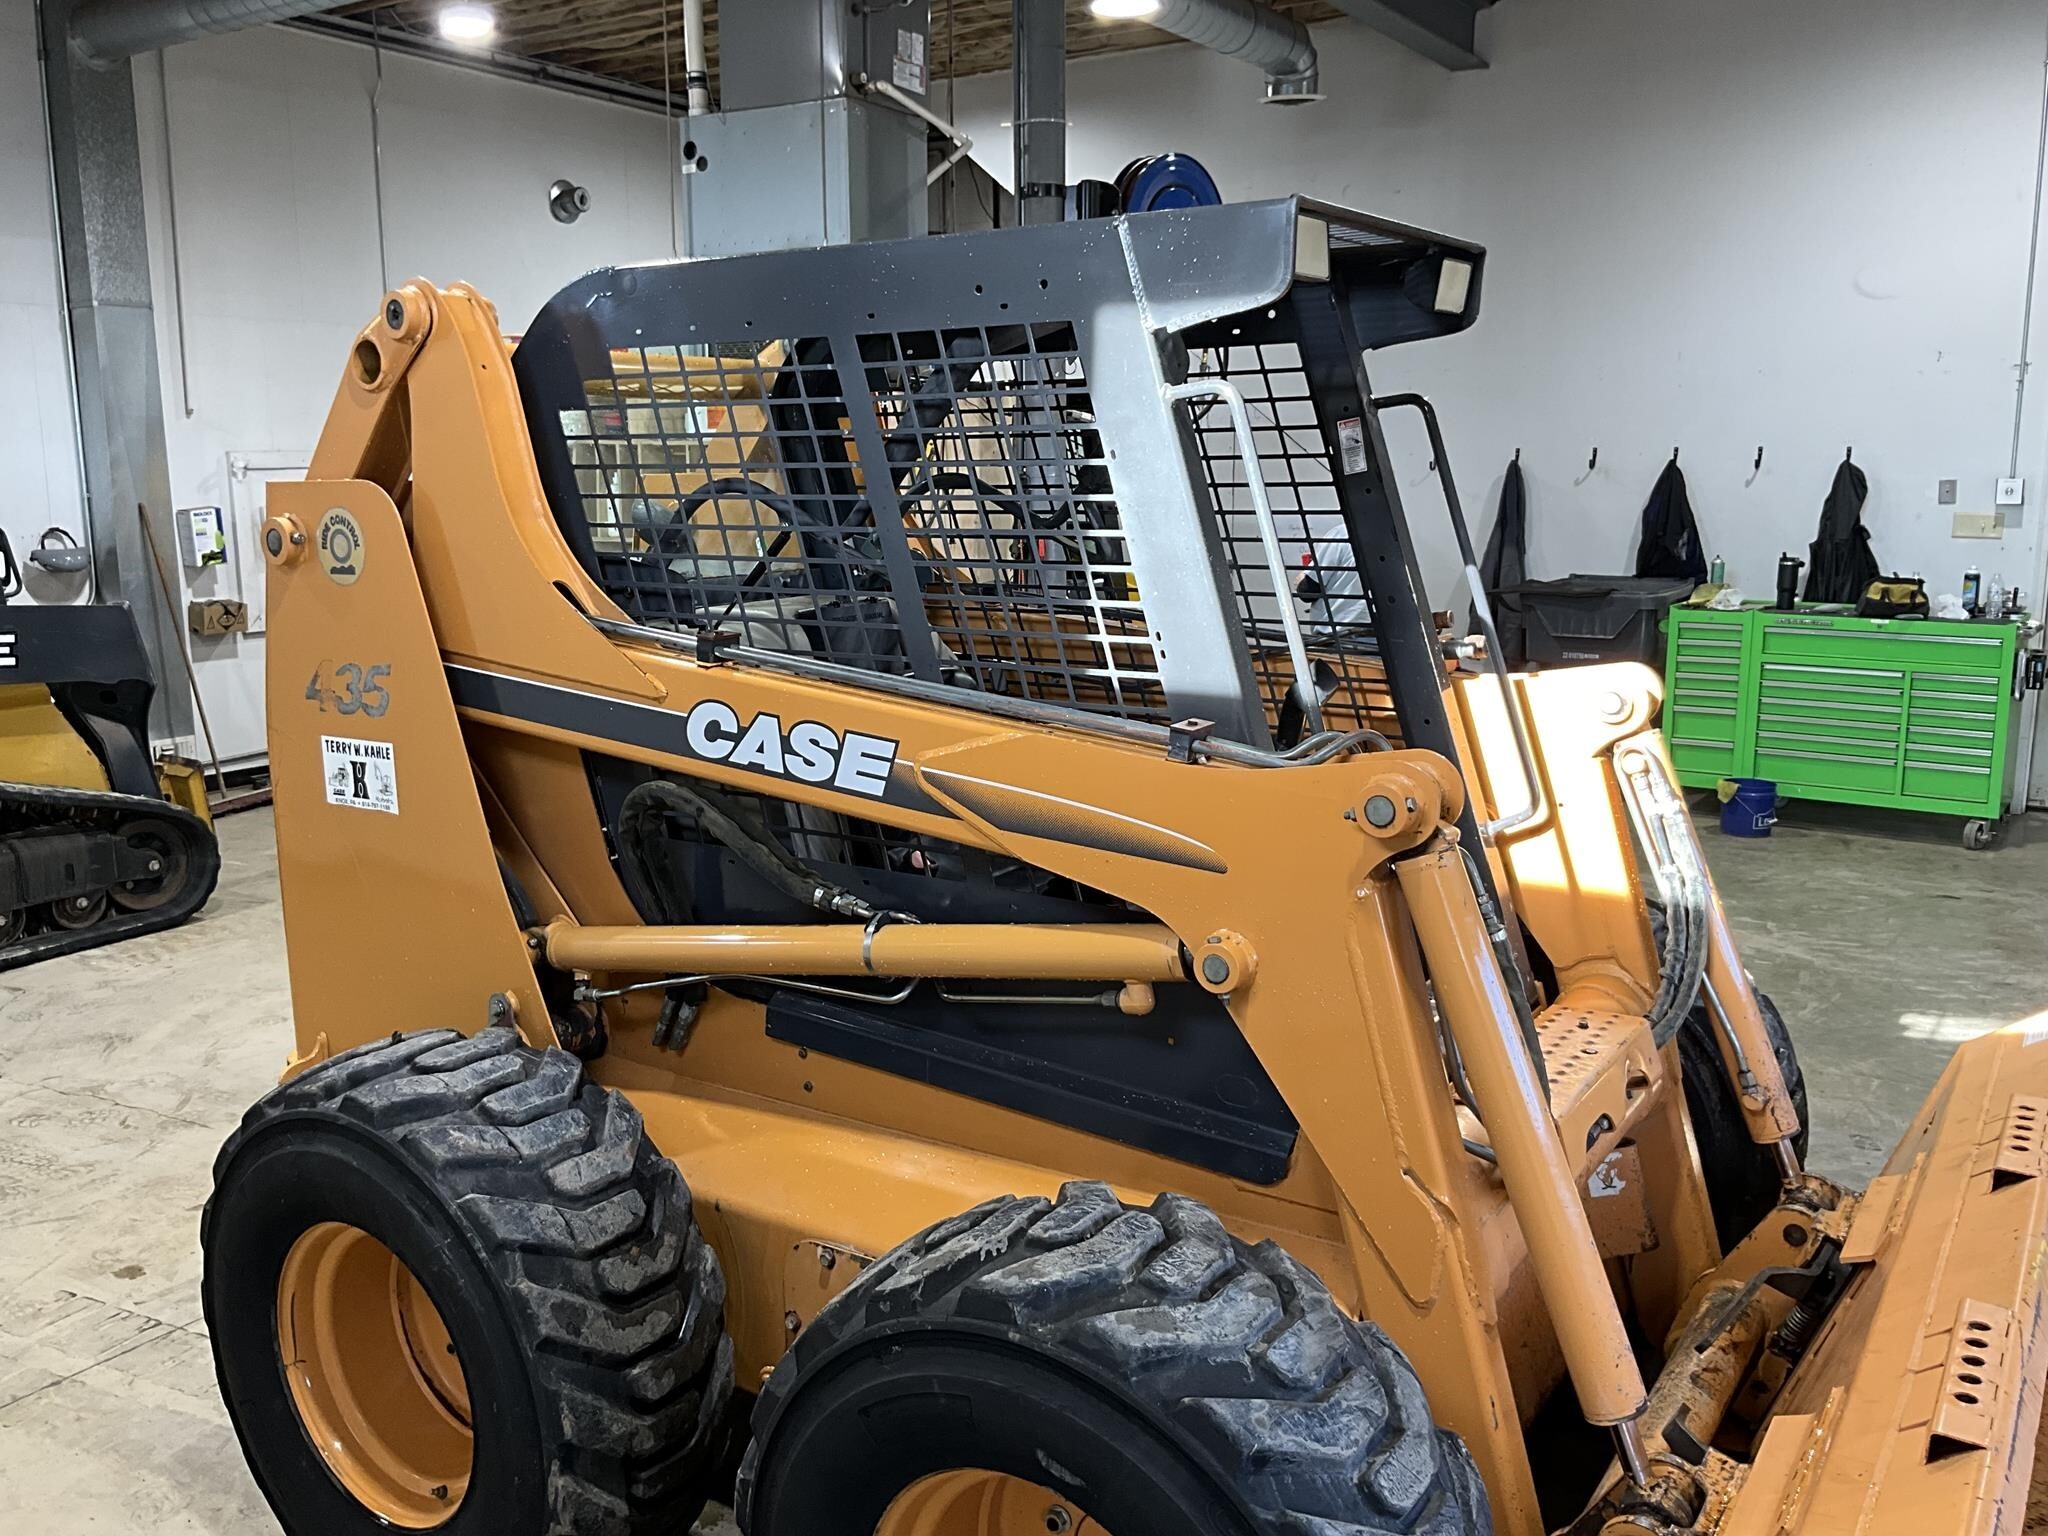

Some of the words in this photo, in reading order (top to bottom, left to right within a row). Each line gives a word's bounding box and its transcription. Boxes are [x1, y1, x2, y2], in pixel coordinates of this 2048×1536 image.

[321, 522, 331, 550] RIDE
[330, 514, 361, 550] CONTROL
[325, 739, 352, 755] TERRY
[354, 744, 363, 757] W.
[364, 745, 391, 760] KAHLE
[685, 700, 898, 798] CASE
